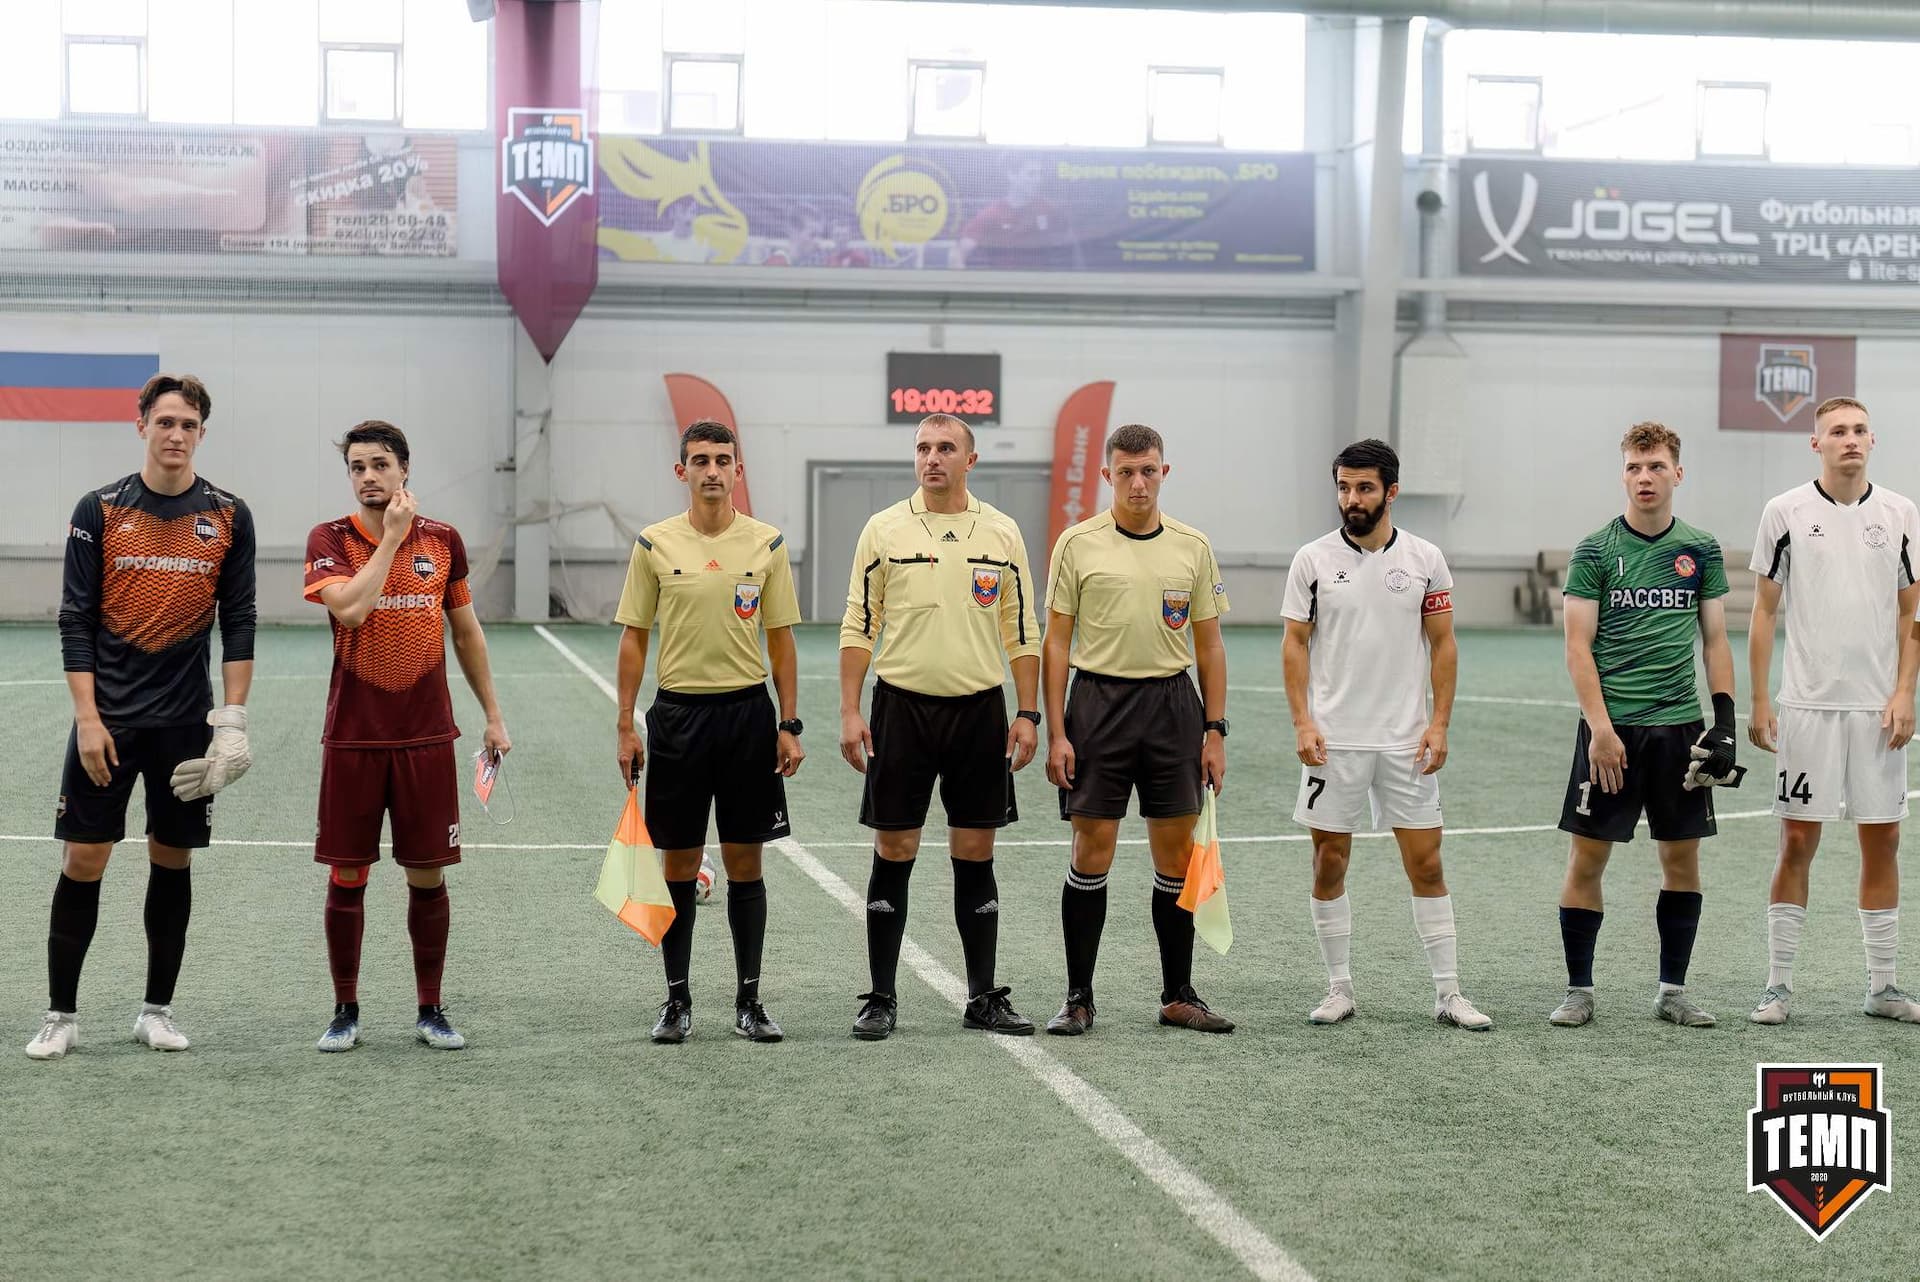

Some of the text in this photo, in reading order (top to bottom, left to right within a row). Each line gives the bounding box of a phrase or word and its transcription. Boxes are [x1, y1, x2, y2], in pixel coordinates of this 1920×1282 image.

[378, 154, 428, 184] 20%
[512, 141, 584, 182] ТЕМП
[882, 194, 939, 215] .БРО
[1760, 198, 1920, 229] Футбольная
[1772, 232, 1831, 261] ТРЦ
[1763, 366, 1811, 394] ТЕМП
[891, 388, 994, 415] 19:00:32
[1610, 588, 1695, 609] РАССВЕТ
[1306, 775, 1326, 810] 7
[1576, 780, 1592, 817] 1
[1778, 769, 1813, 805] 14
